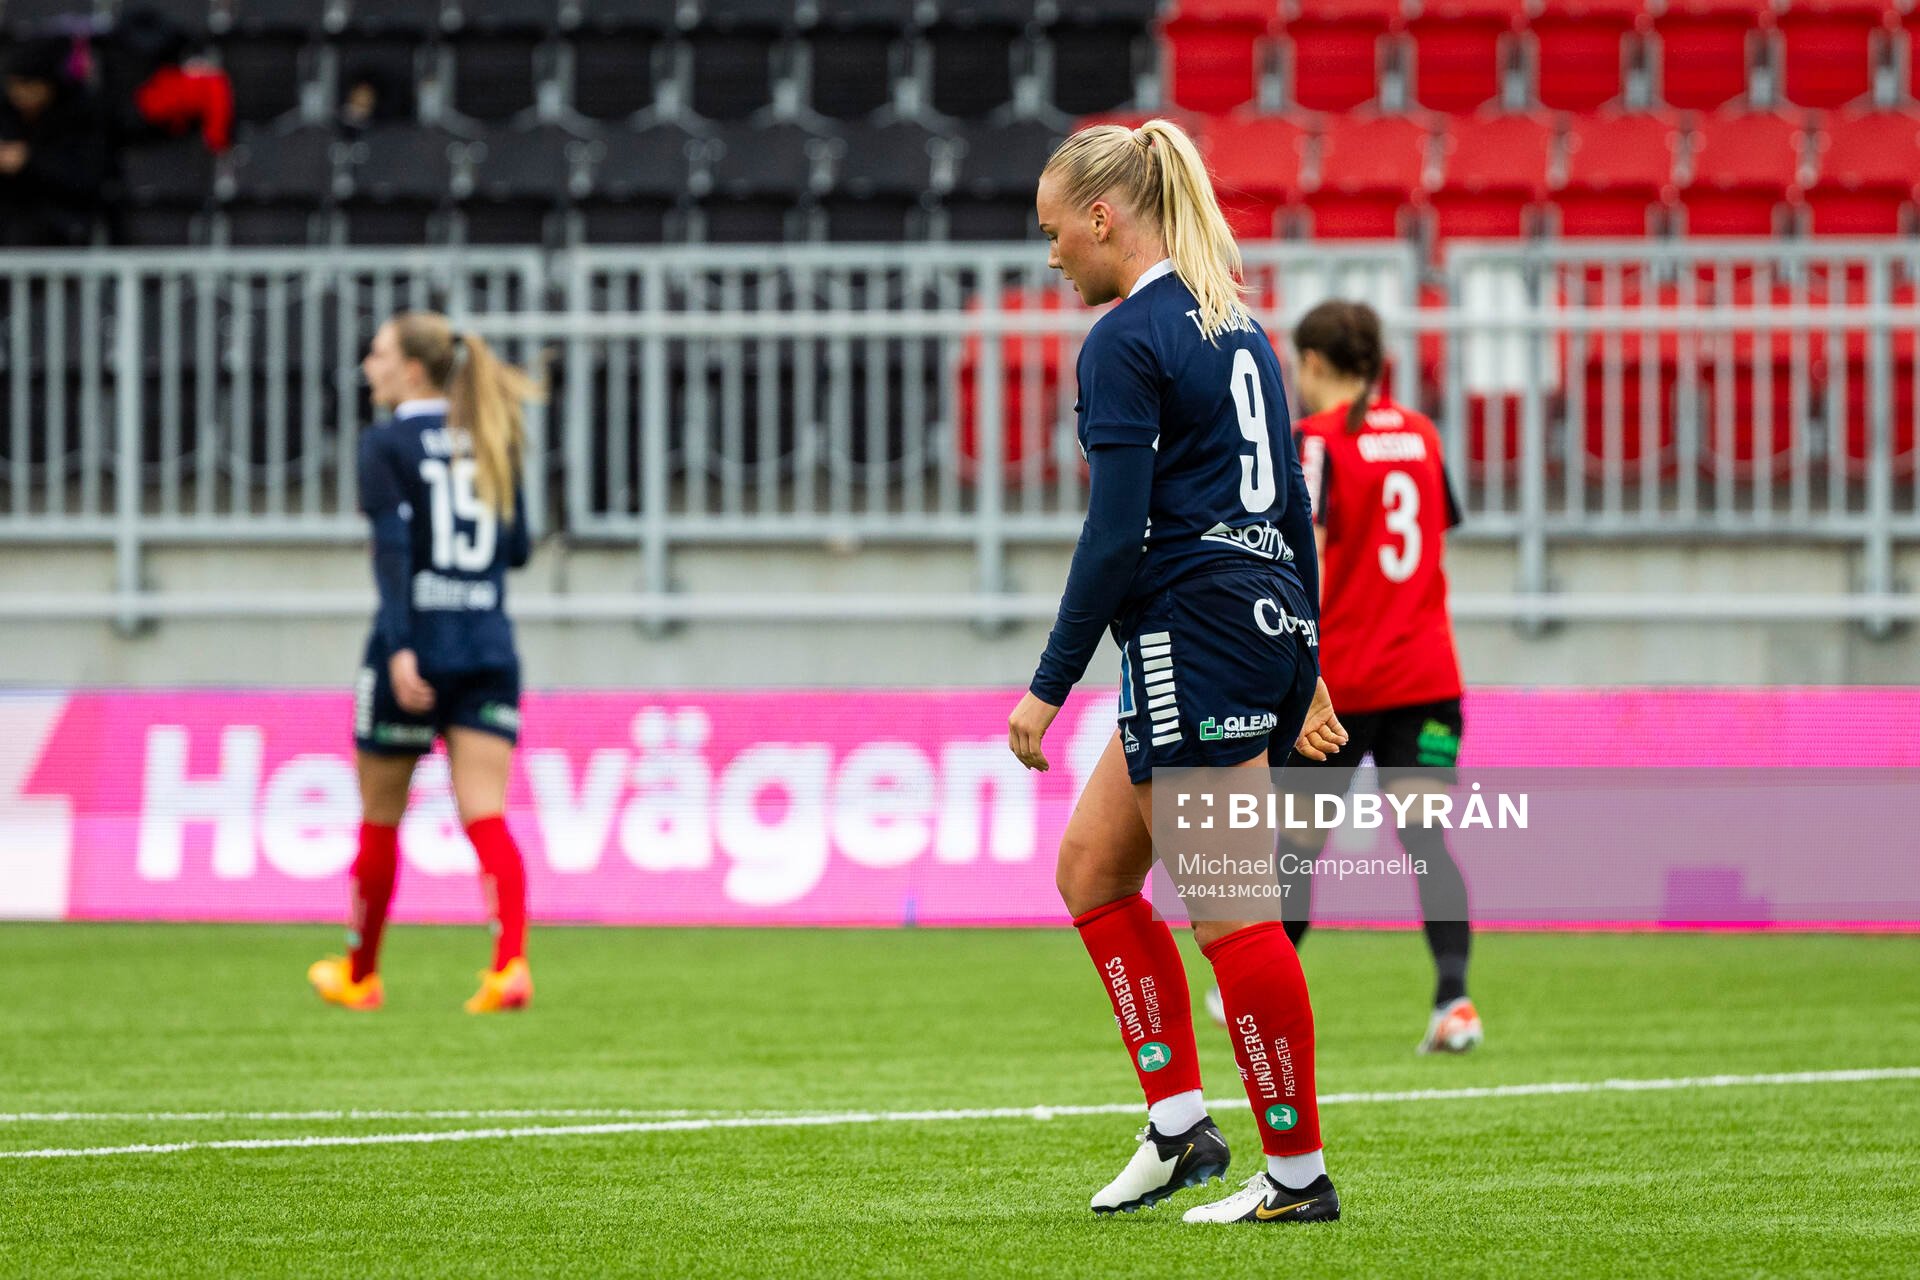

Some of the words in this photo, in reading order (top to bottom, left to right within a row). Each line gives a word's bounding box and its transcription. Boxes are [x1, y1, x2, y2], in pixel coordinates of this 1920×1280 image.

[1230, 349, 1276, 513] 9
[419, 458, 496, 572] 15
[1378, 470, 1422, 583] 3
[1223, 712, 1278, 732] QLEAN
[137, 725, 482, 880] Hea
[526, 706, 1038, 905] vägen
[1105, 956, 1144, 1042] LUNDBERGS
[1236, 1014, 1278, 1099] LUNDBERGS
